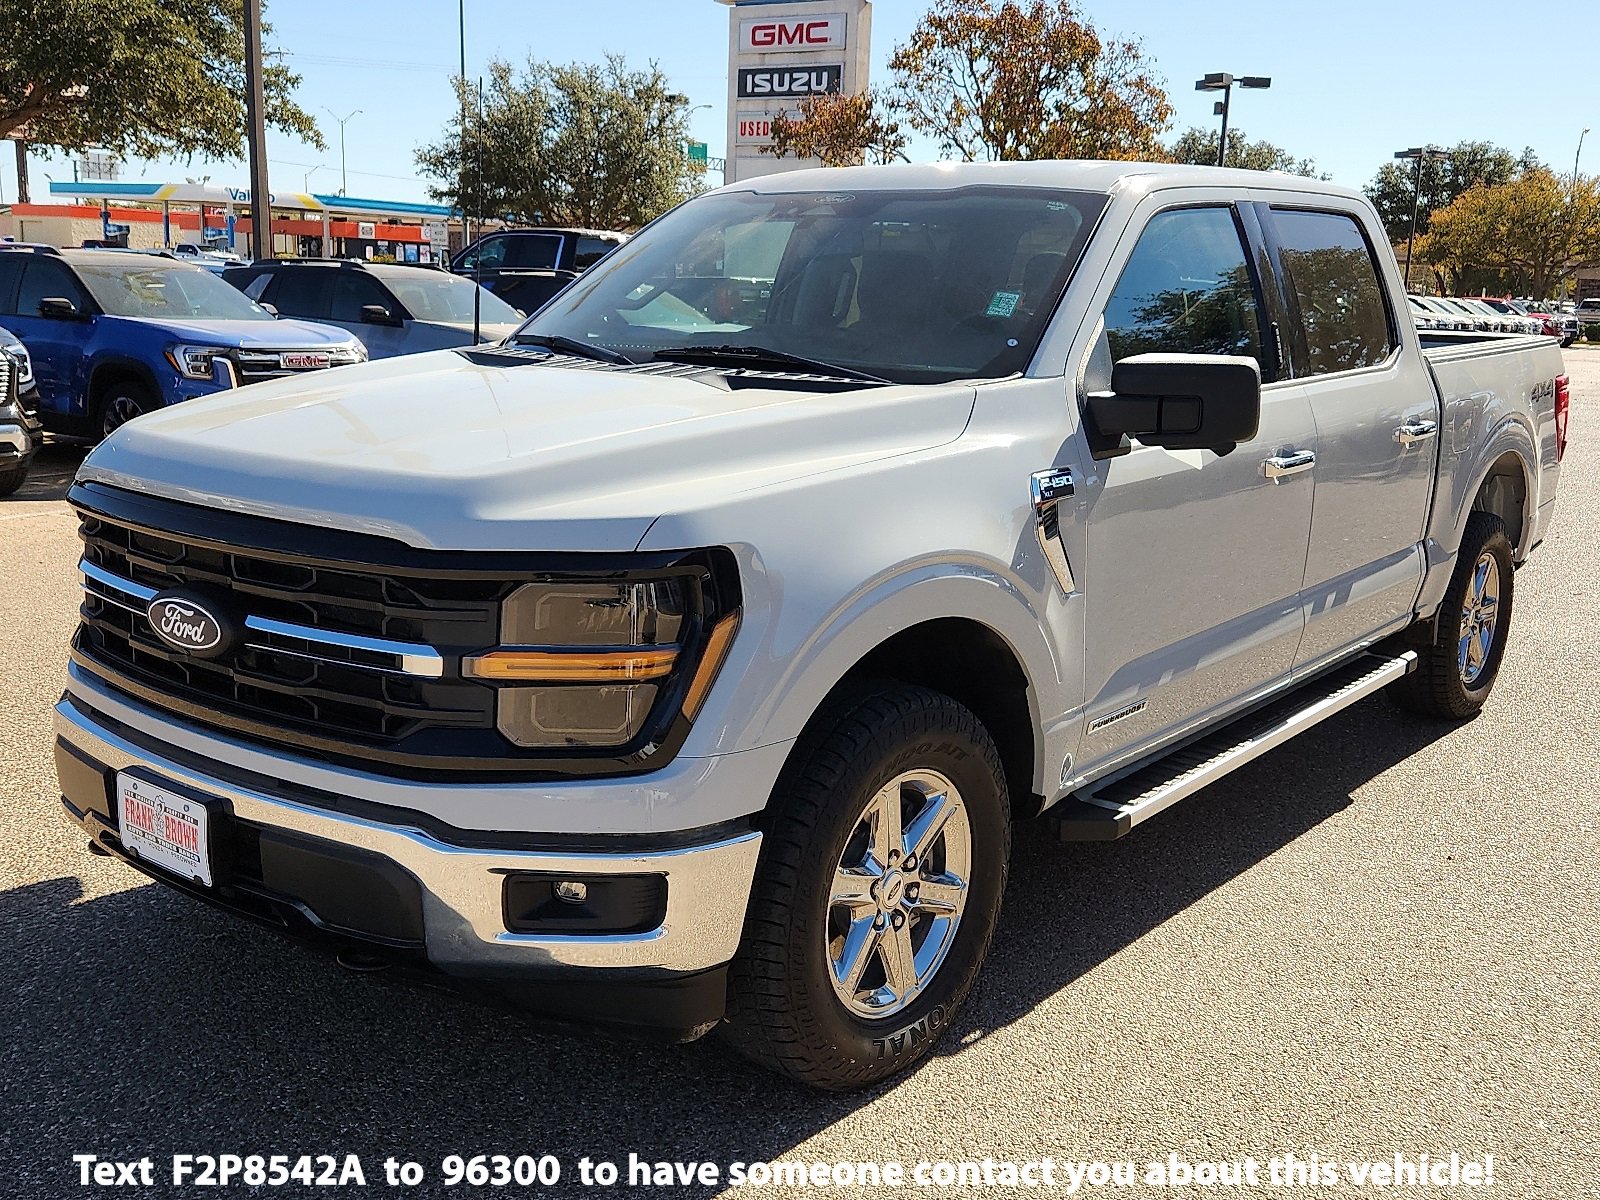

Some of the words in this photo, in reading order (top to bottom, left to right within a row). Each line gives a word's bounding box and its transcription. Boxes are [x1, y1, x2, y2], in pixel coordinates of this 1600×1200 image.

[751, 21, 830, 46] GMC
[746, 71, 828, 93] ISUZU
[740, 121, 769, 136] USED
[229, 187, 276, 203] Valo
[1043, 490, 1054, 498] XLT
[161, 603, 206, 643] Ford
[124, 796, 154, 832] FRANK
[164, 814, 199, 854] BROWN
